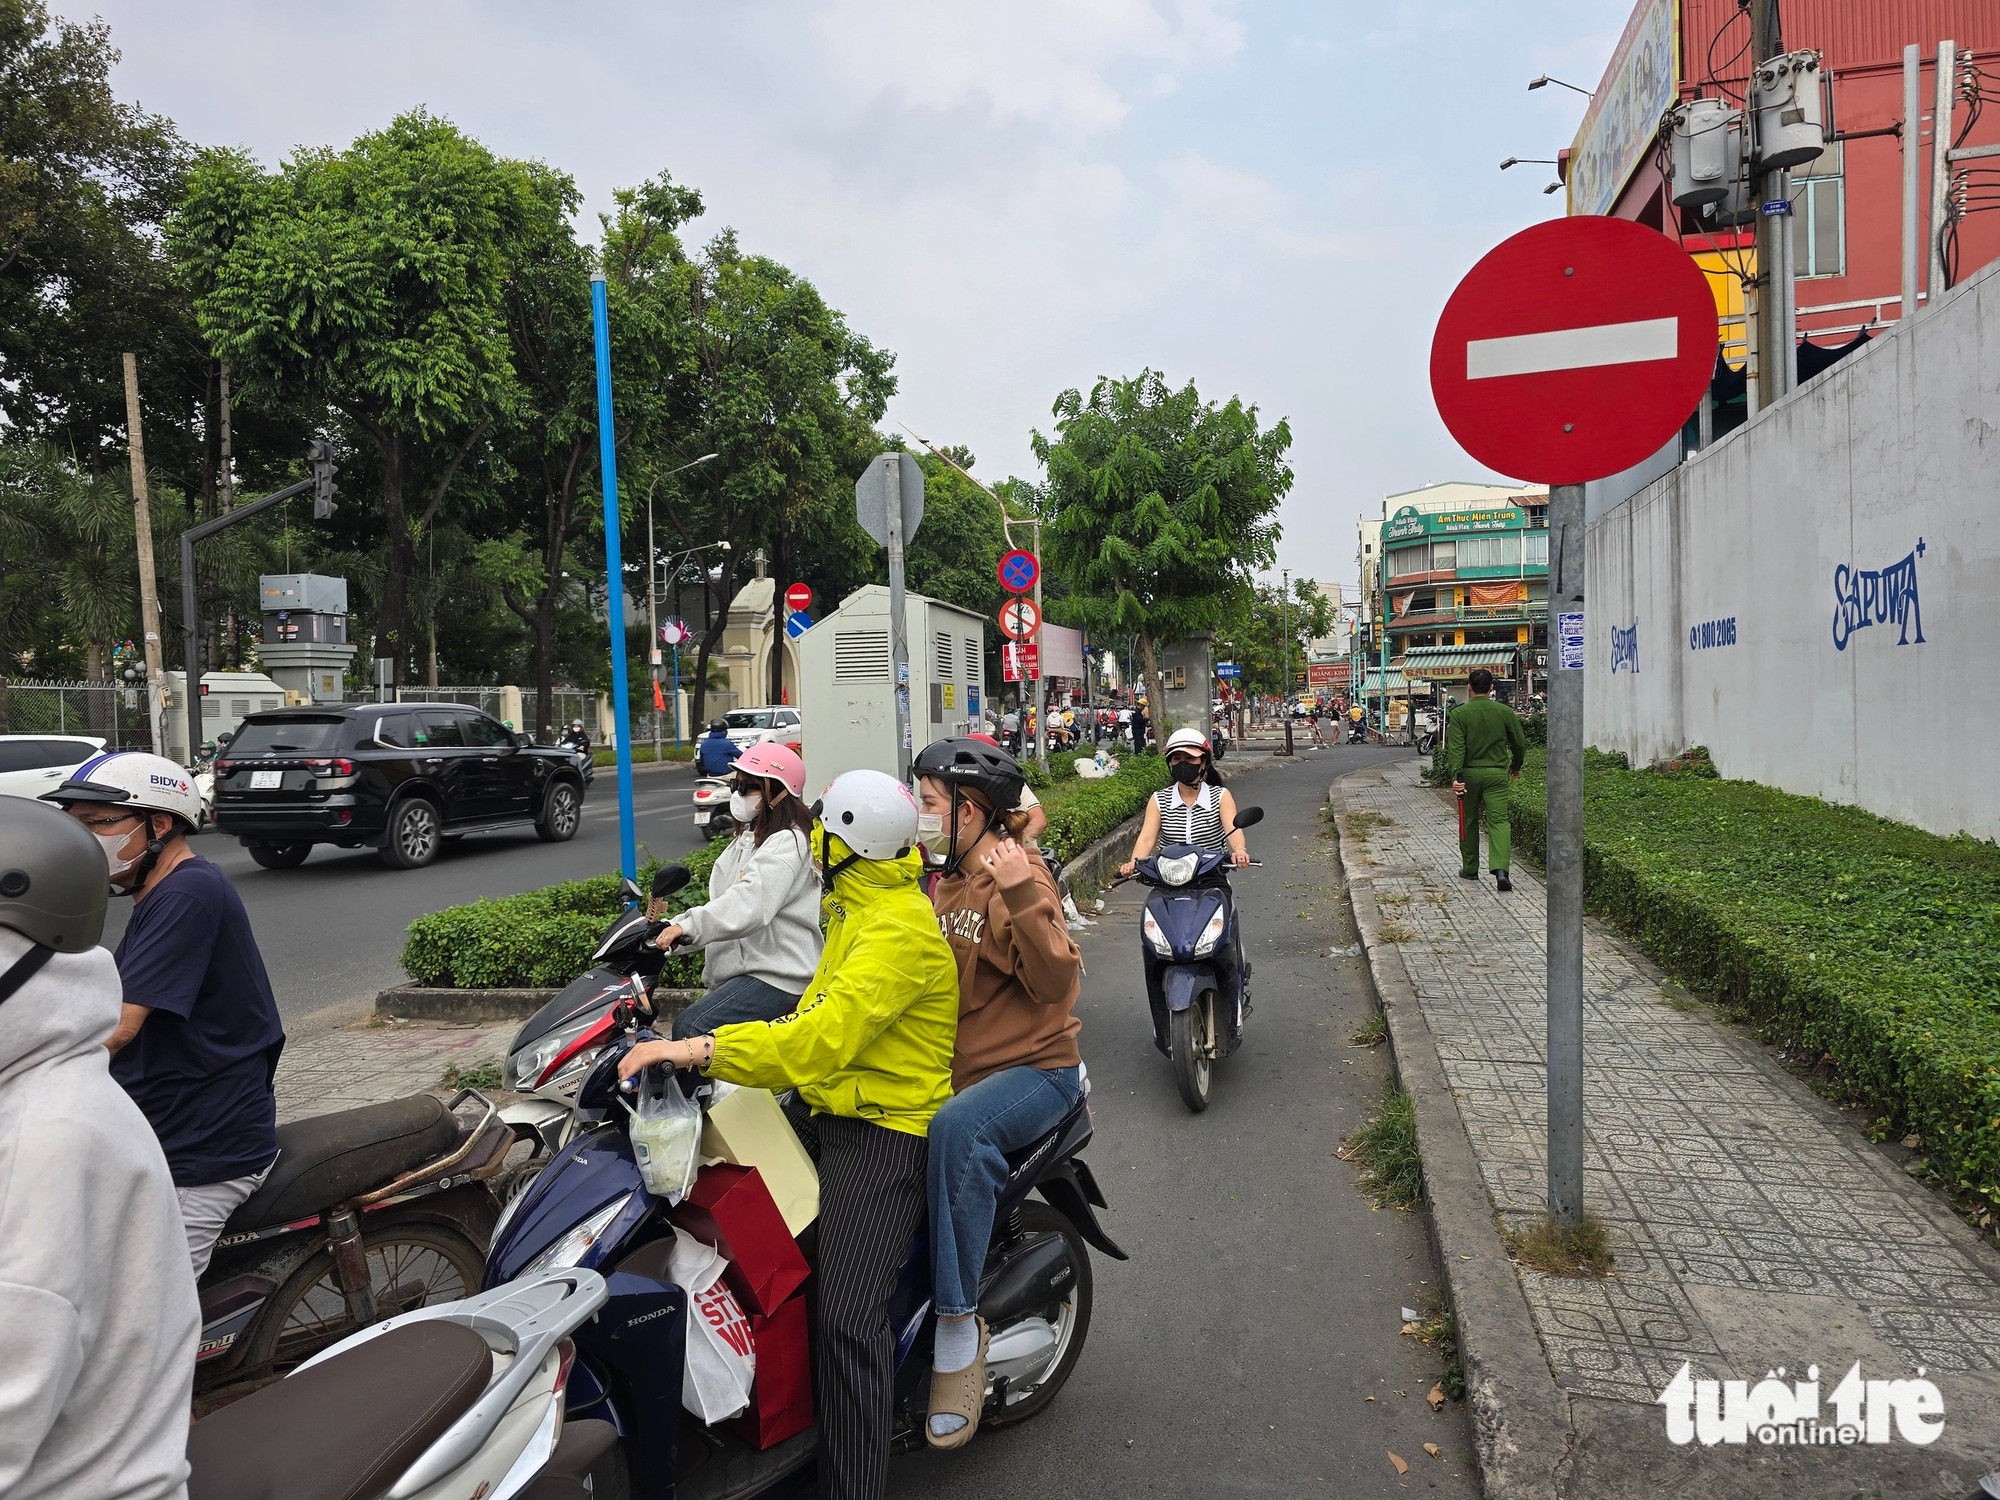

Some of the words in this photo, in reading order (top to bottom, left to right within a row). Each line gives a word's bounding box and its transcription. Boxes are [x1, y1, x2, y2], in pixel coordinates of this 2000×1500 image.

[1493, 511, 1516, 520] Trung
[1697, 621, 1716, 650] 1800
[1716, 617, 1737, 647] 2085
[150, 774, 178, 788] BIDV
[213, 1231, 261, 1248] NDA
[626, 1305, 677, 1328] HONDA
